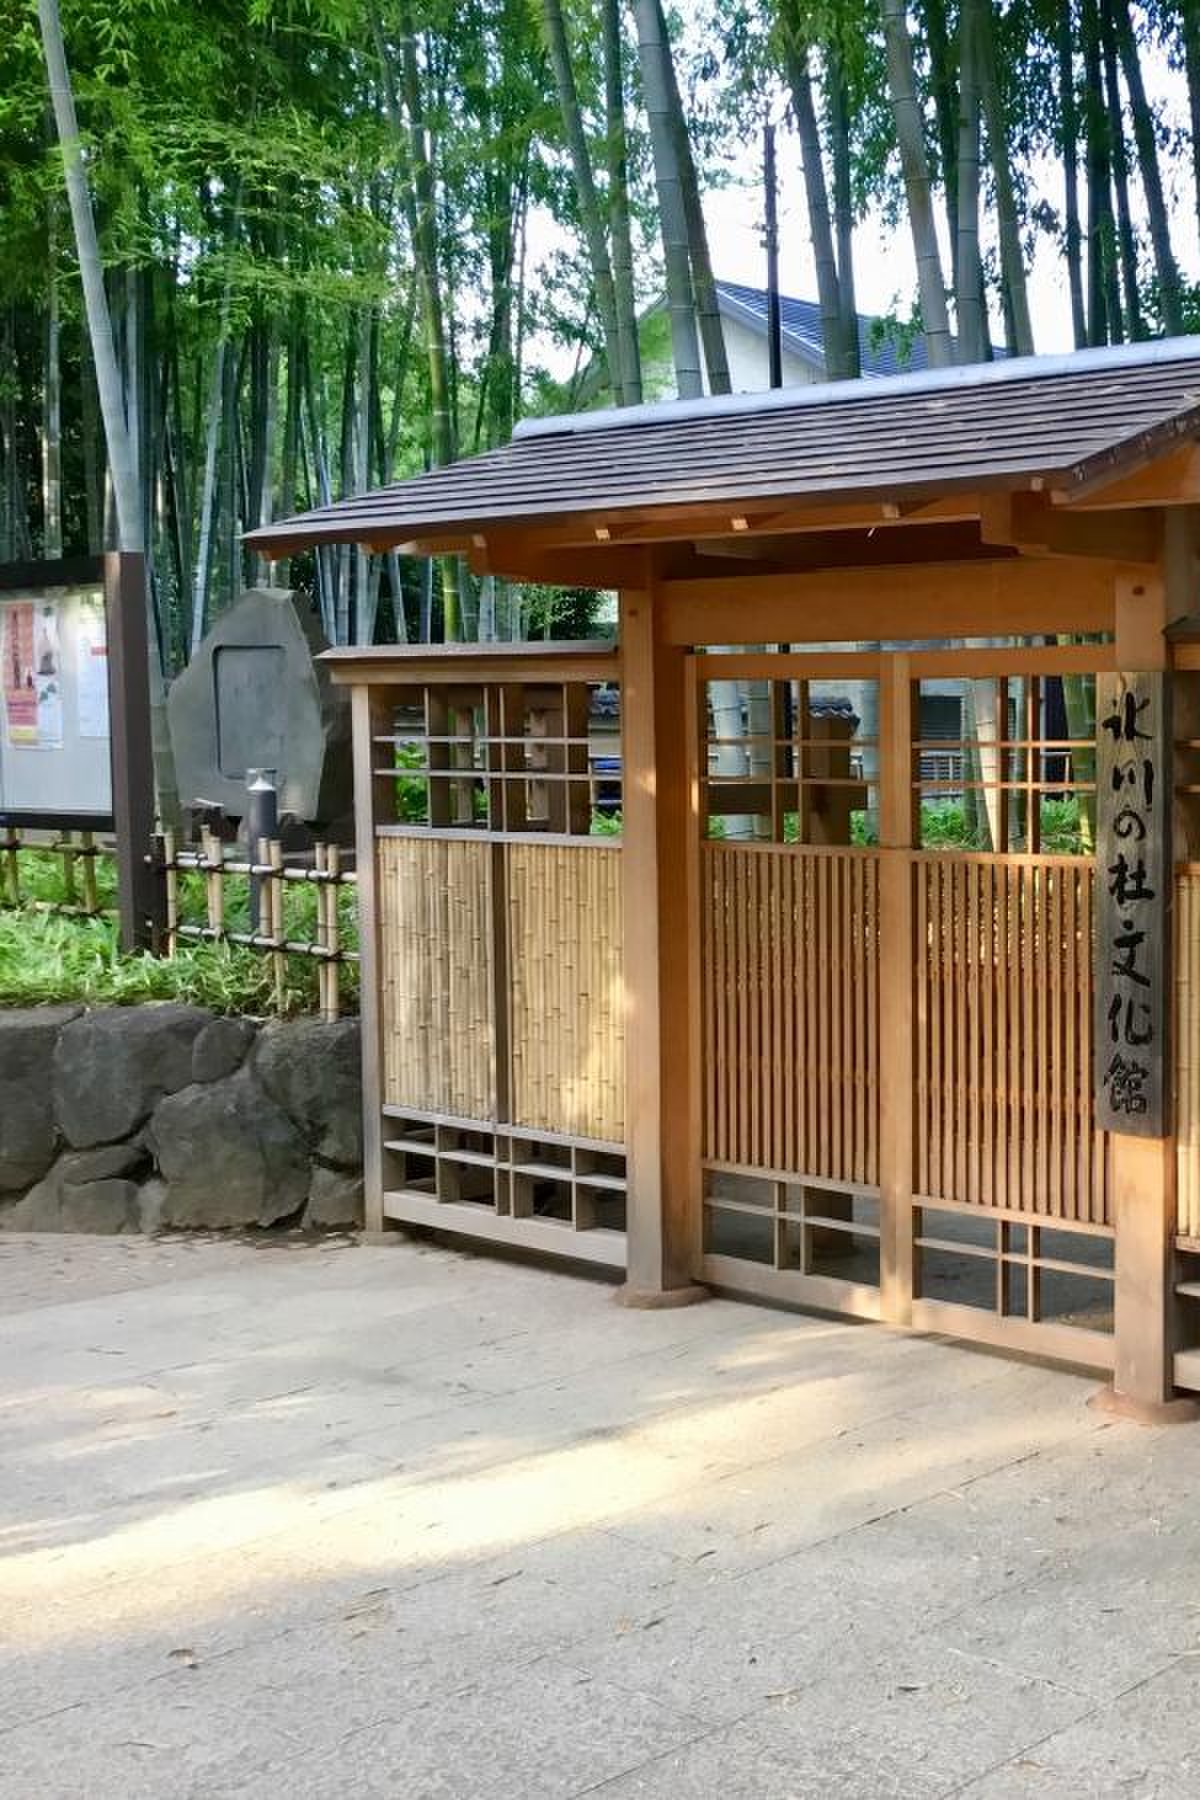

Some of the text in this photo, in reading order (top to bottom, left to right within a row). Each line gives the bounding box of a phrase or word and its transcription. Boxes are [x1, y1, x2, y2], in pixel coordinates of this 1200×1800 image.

[1102, 691, 1155, 1115] 氷川の杜文化館
